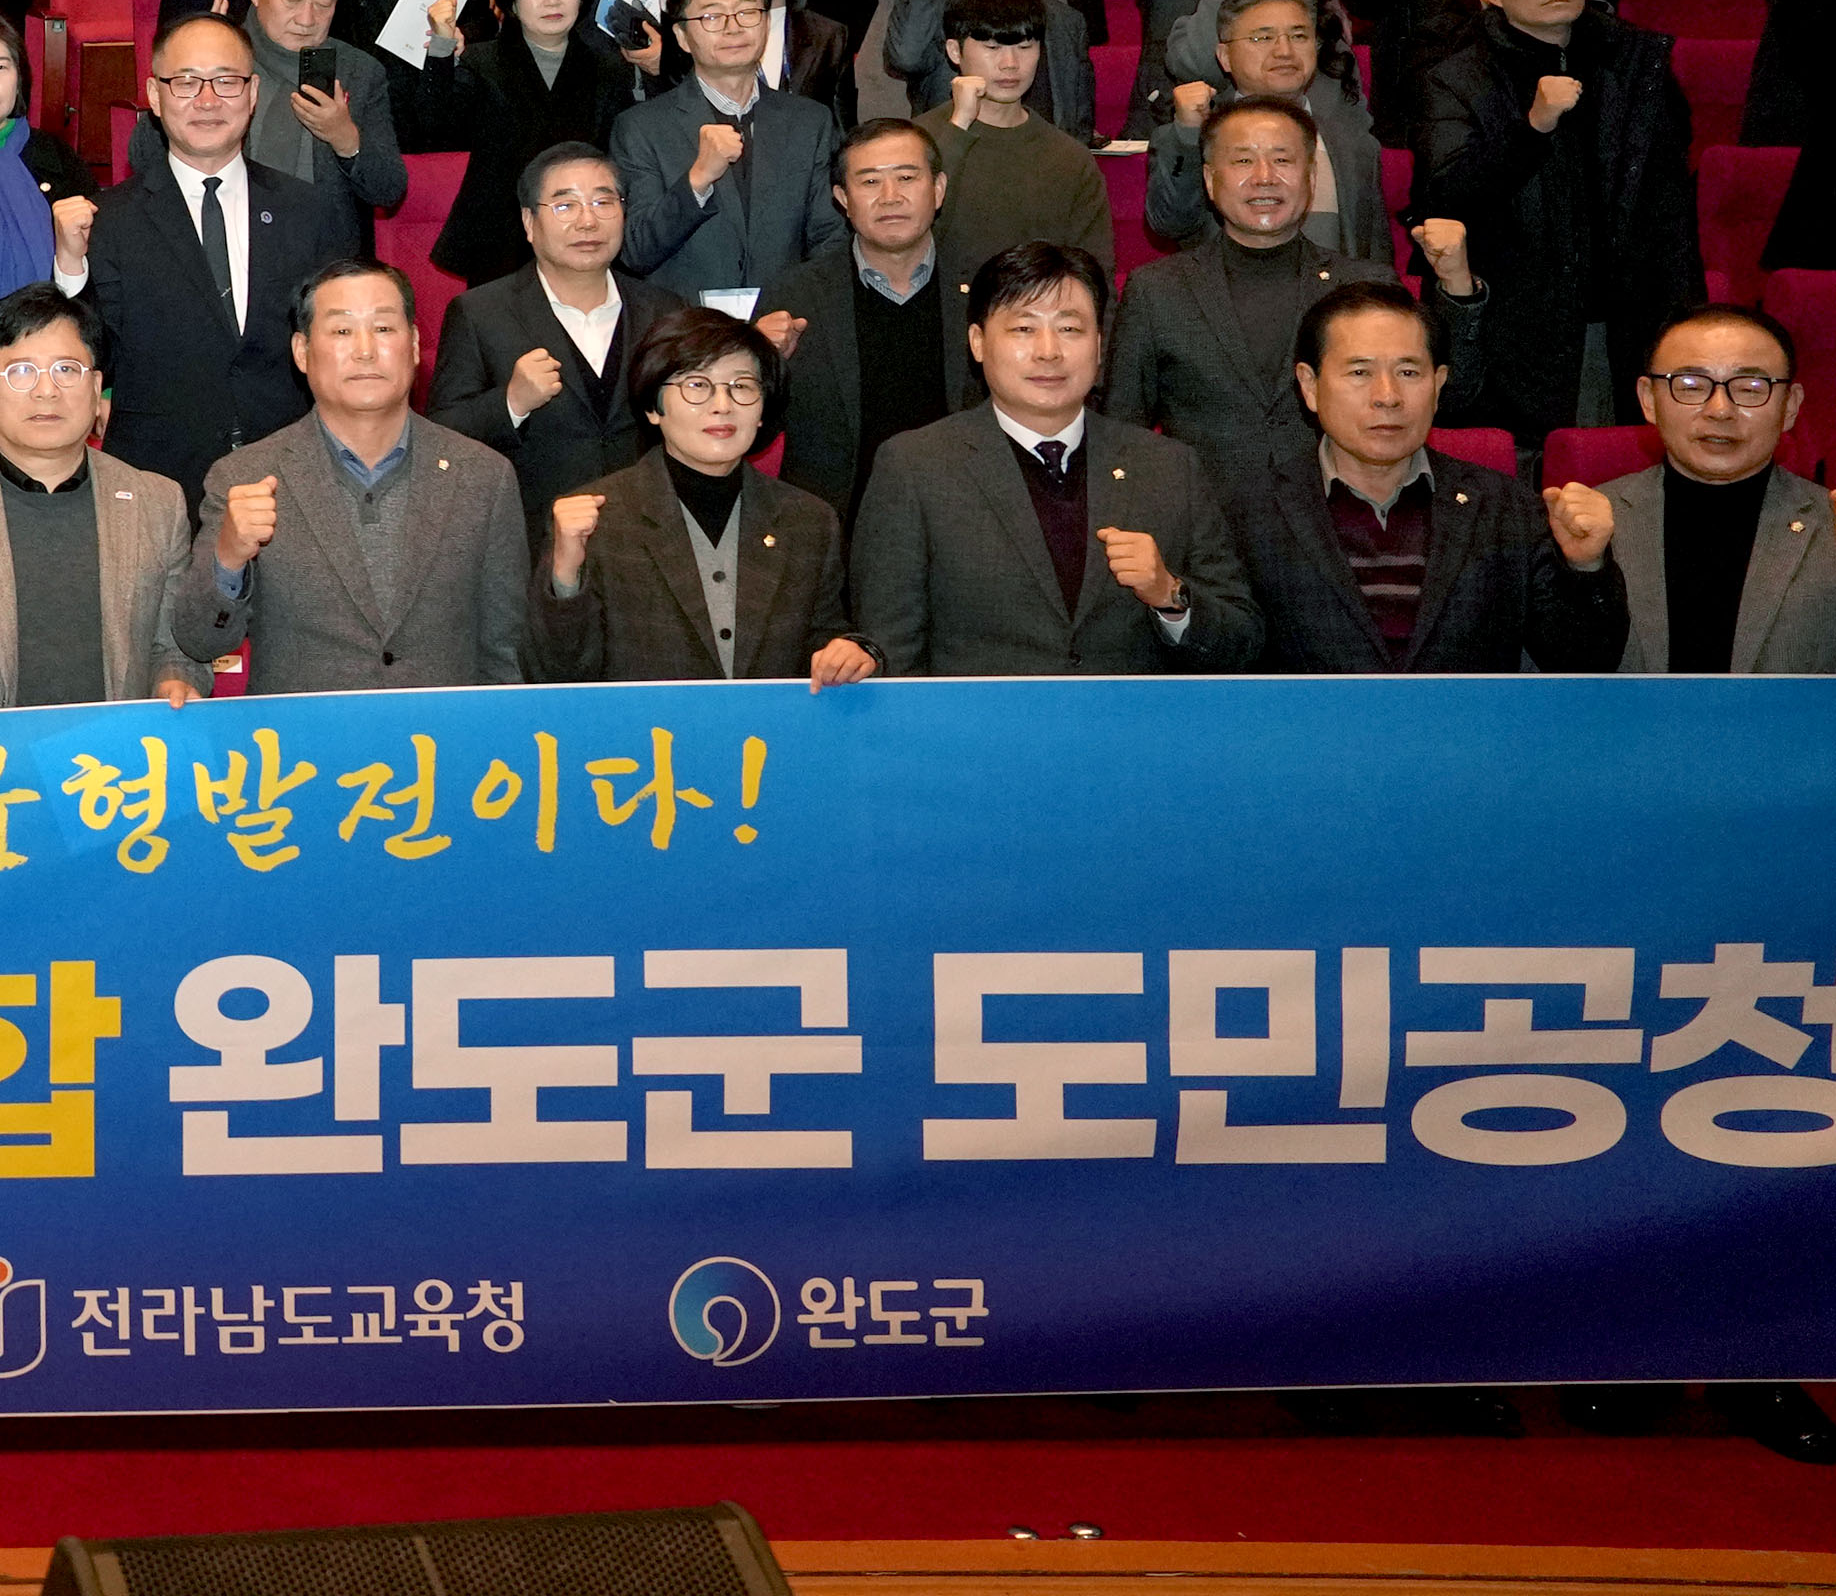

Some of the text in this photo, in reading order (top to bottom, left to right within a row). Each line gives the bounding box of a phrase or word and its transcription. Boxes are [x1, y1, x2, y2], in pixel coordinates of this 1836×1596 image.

[169, 948, 863, 1176] 완도군
[71, 1278, 525, 1357] 전라남도교육청
[797, 1277, 989, 1348] 완도군
